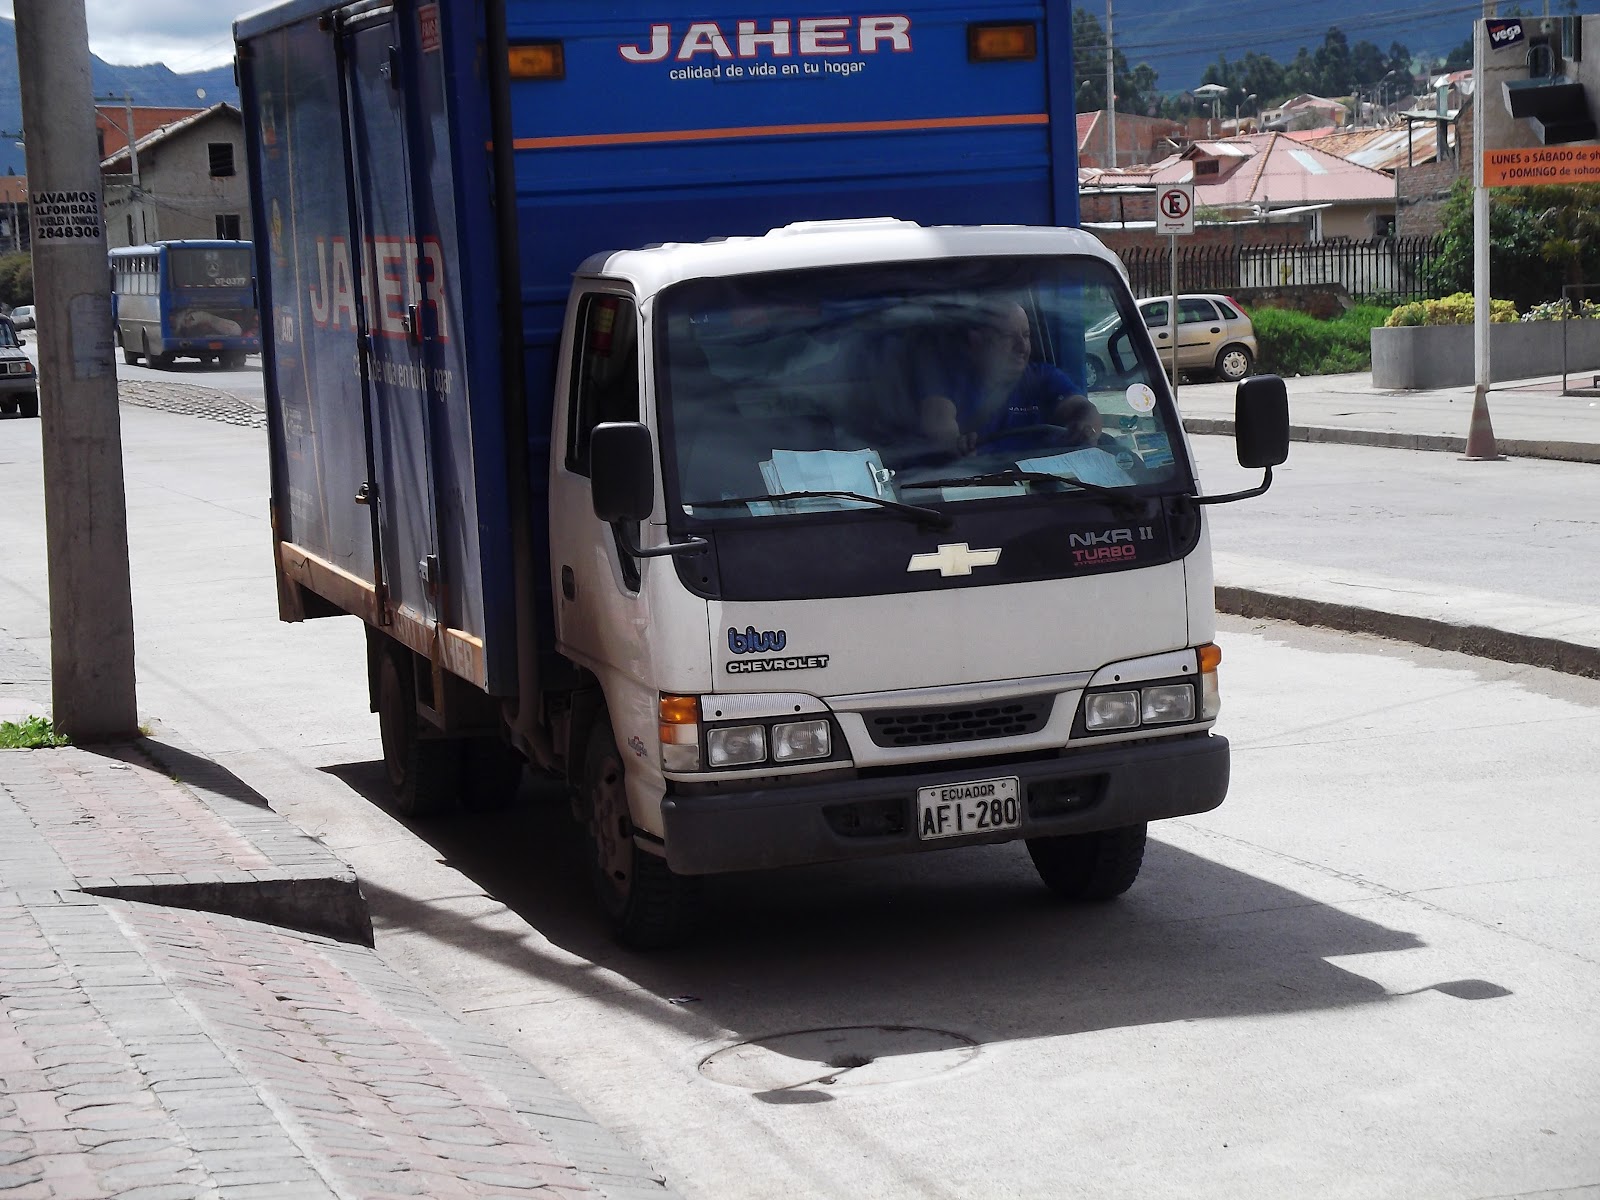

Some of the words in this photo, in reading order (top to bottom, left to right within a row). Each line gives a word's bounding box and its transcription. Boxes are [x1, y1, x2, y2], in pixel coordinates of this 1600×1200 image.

[618, 15, 912, 63] JAHER
[1492, 25, 1521, 42] vega
[669, 65, 721, 80] calidad
[725, 64, 743, 77] de
[748, 62, 777, 76] vida
[781, 64, 799, 75] en
[804, 62, 819, 73] tu
[824, 60, 866, 76] hogar
[1491, 154, 1521, 165] LUNES
[1524, 155, 1530, 163] a
[1533, 150, 1573, 162] SÁBADO
[1576, 151, 1587, 160] de
[1501, 171, 1507, 180] y
[1509, 167, 1556, 178] DOMINGO
[1560, 167, 1570, 175] de
[33, 192, 97, 204] LAVAMOS
[1169, 195, 1181, 214] E
[36, 205, 98, 216] ALFOMBRAS
[38, 227, 100, 239] 2848306
[1069, 528, 1133, 547] NKR
[1072, 544, 1136, 561] TURBO
[727, 656, 829, 673] CHEVROLET
[941, 784, 995, 801] ECUADOR
[923, 797, 1017, 836] AFI-280
